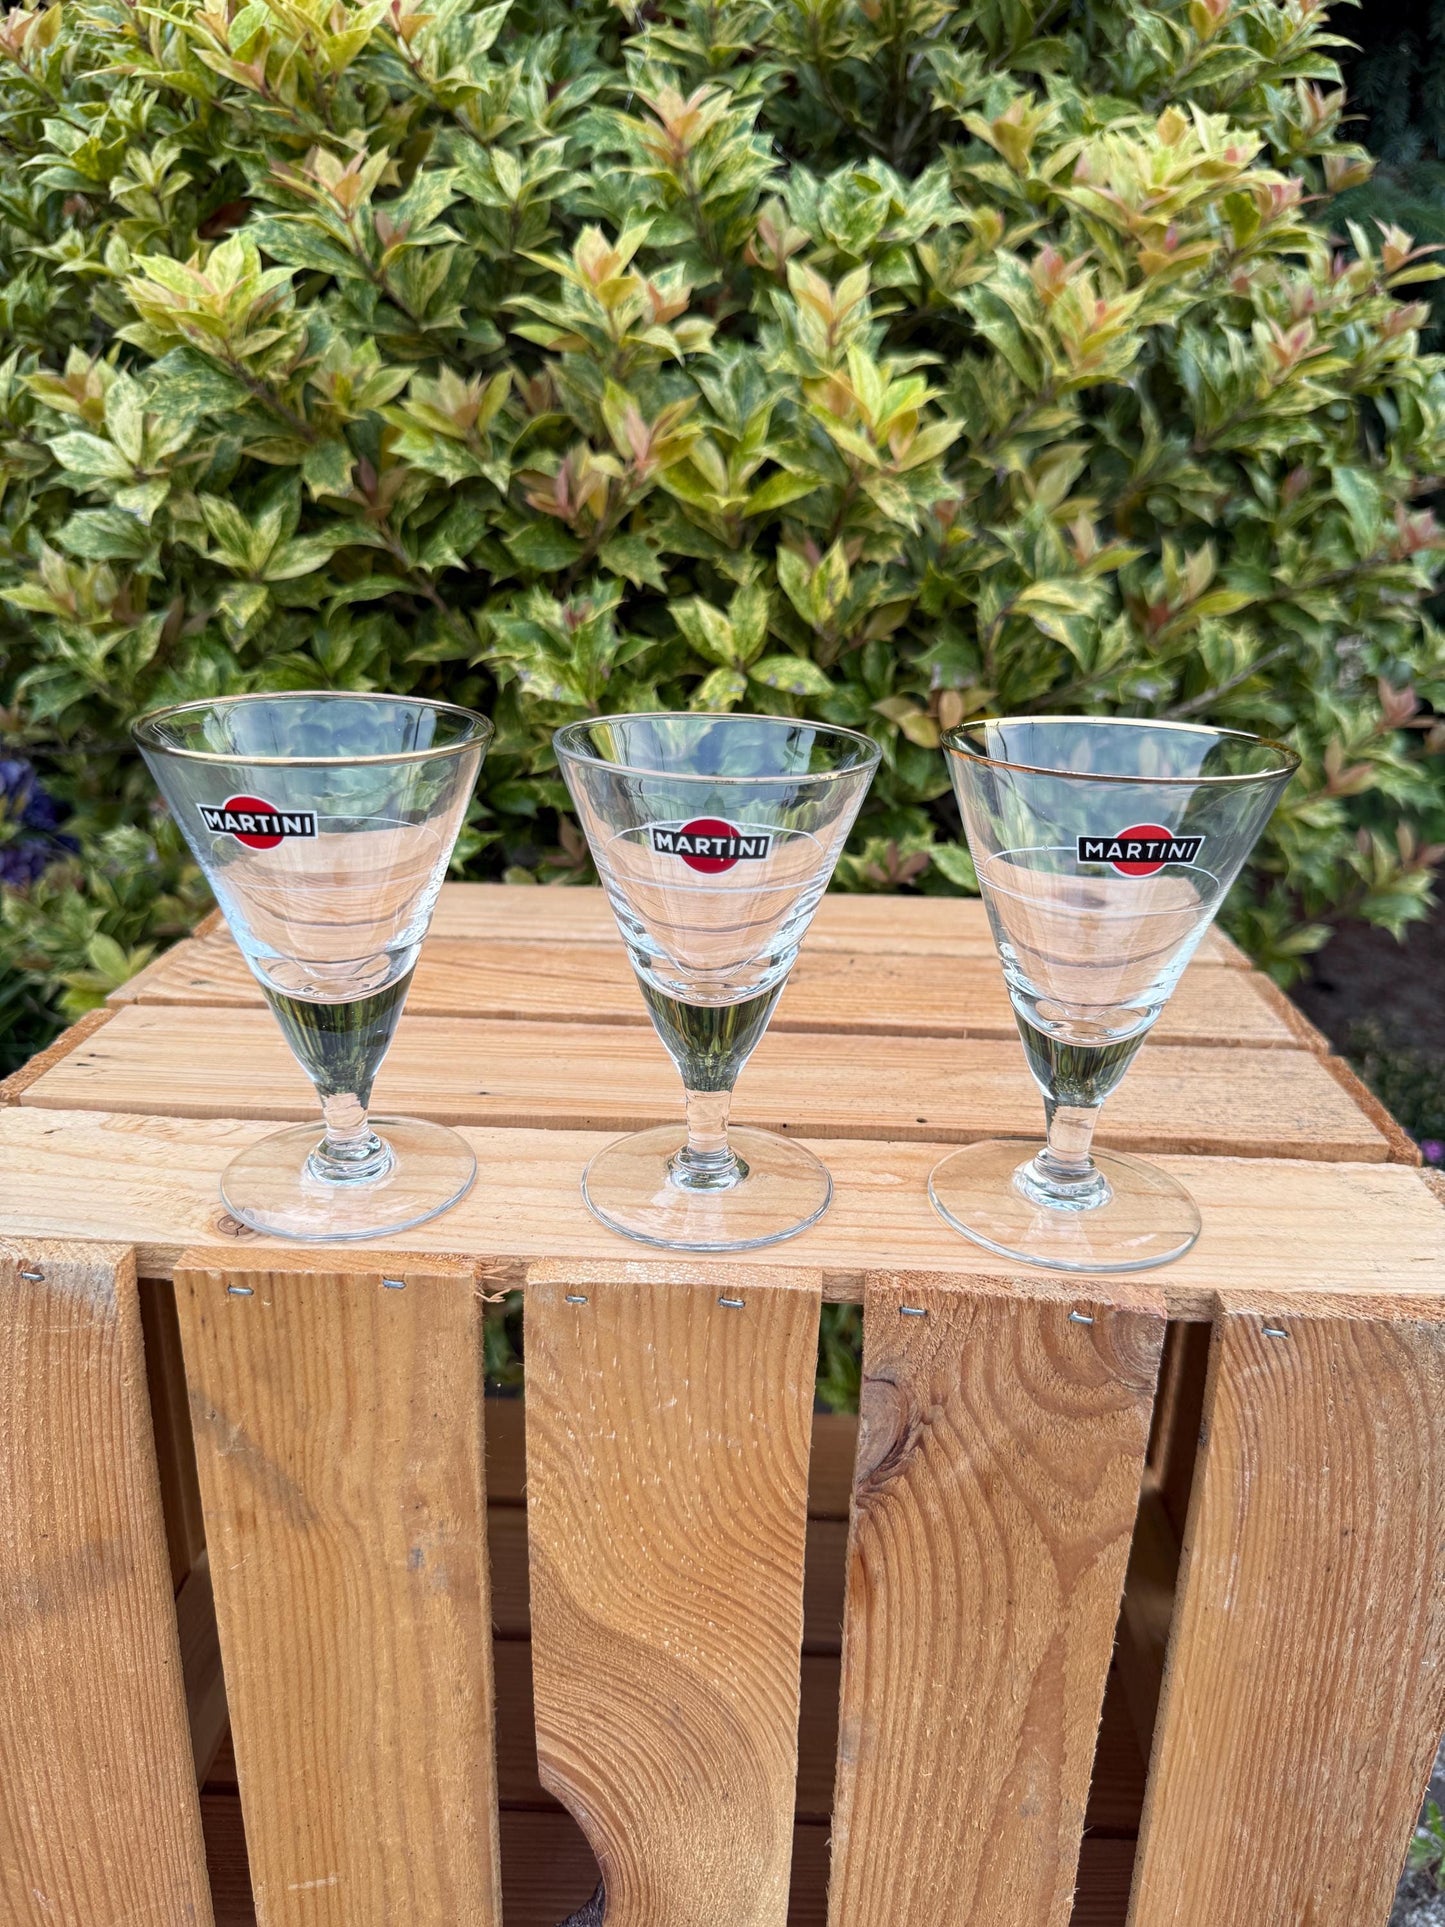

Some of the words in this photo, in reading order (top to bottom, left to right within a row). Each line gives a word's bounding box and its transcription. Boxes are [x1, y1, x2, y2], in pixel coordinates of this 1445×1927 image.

[203, 810, 312, 833] MARTINI
[655, 832, 766, 856] MARTINI
[1085, 841, 1195, 859] MARTINI
